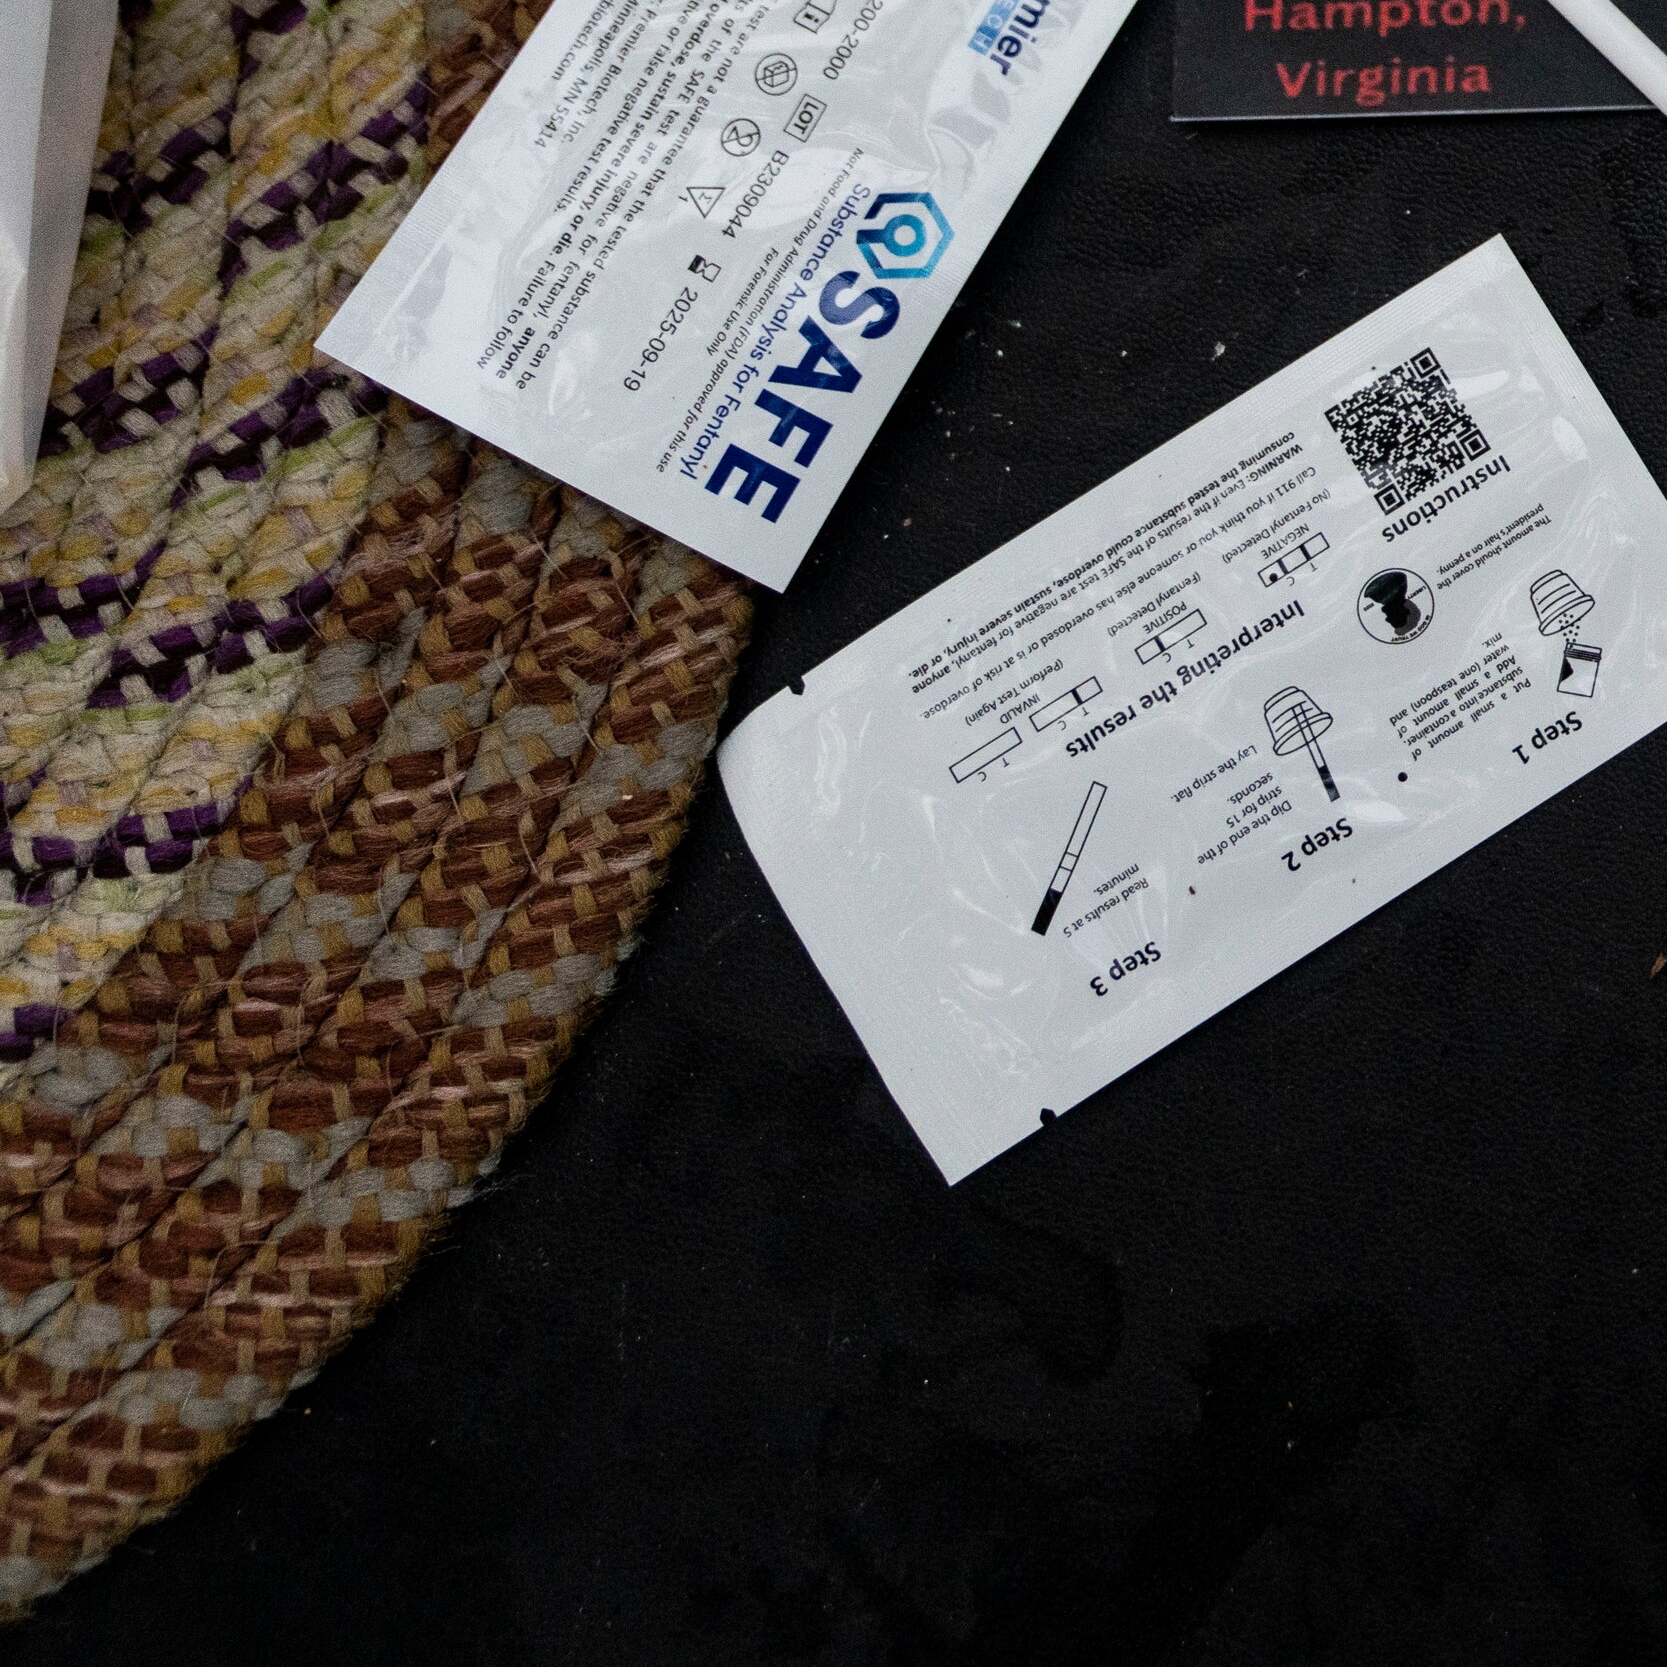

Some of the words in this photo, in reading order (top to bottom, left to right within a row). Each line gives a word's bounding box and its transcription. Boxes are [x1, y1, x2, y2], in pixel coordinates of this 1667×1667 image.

[1275, 56, 1490, 107] Virginia
[793, 101, 819, 135] LOT
[720, 149, 790, 239] B2309044
[799, 190, 870, 282] Substance
[622, 285, 699, 392] 2025-09-19
[749, 282, 807, 362] Analysis
[704, 270, 901, 524] SAFE
[732, 363, 760, 394] for
[679, 393, 742, 481] Fentanyl
[1381, 454, 1512, 543] Instructions
[1260, 523, 1310, 560] NEGATIVE
[1142, 600, 1188, 635] POSITIVE
[1175, 599, 1306, 687] Interpreting
[1138, 680, 1178, 710] the
[1064, 704, 1138, 758] results
[1530, 710, 1583, 750] Step
[1511, 744, 1531, 765] 1
[1300, 817, 1354, 857] Step
[1280, 850, 1302, 872] 2
[1108, 940, 1162, 982] Step
[1089, 975, 1109, 998] 3
